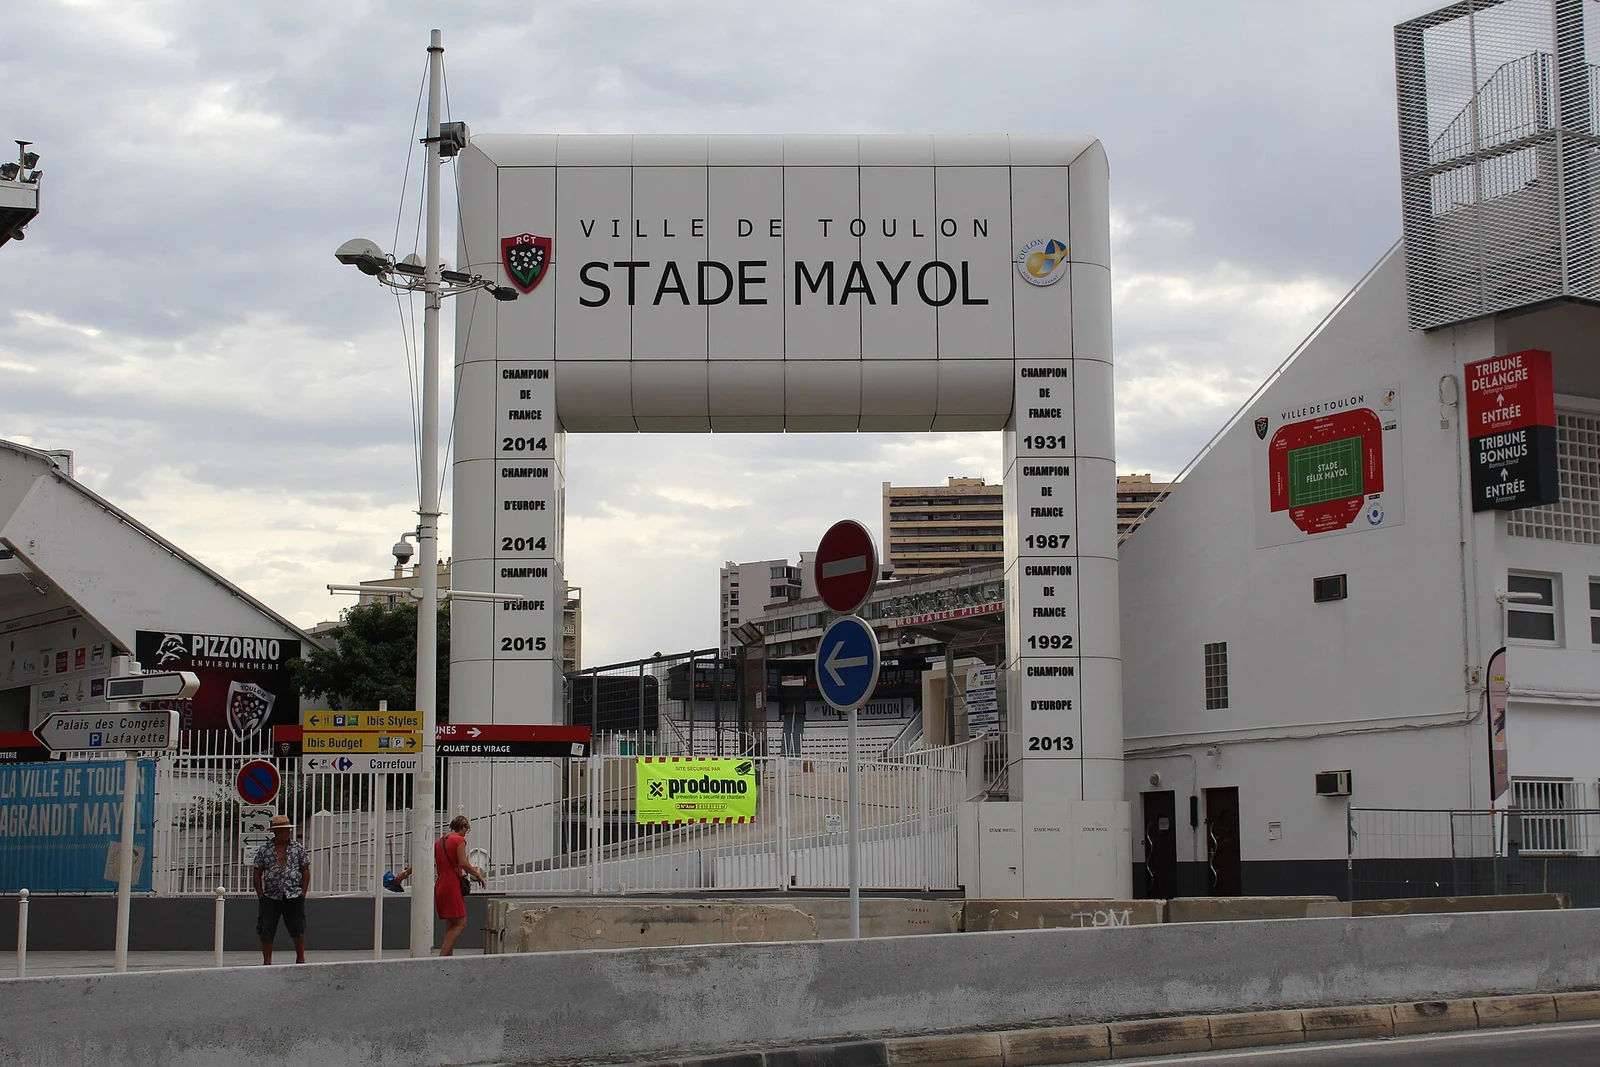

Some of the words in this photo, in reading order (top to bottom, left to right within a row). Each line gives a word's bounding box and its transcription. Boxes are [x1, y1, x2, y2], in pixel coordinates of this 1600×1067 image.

[580, 219, 704, 238] VILLE
[738, 219, 782, 238] DE
[818, 218, 989, 238] TOULON
[516, 234, 537, 245] RCT
[1018, 238, 1044, 266] TOULON
[579, 260, 768, 307] STADE
[794, 260, 989, 307] MAYOL
[1475, 355, 1523, 377] TRIBUNE
[502, 369, 549, 380] CHAMPION
[1020, 367, 1067, 379] CHAMPION
[1471, 367, 1529, 392] DELANGRE
[520, 389, 531, 400] DE
[1039, 388, 1050, 399] DE
[1482, 386, 1503, 396] Delangre
[1503, 383, 1518, 392] Stand
[1029, 408, 1062, 419] FRANCE
[1281, 408, 1307, 420] VILLE
[1309, 404, 1321, 414] DE
[1324, 395, 1365, 412] TOULON
[508, 410, 542, 420] FRANCE
[1481, 404, 1522, 425] ENTRÉE
[1491, 420, 1512, 429] Entrance
[502, 437, 547, 451] 2014
[1023, 435, 1067, 450] 1931
[1479, 430, 1527, 451] TRIBUNE
[1480, 444, 1528, 464] BONNUS
[1317, 461, 1338, 472] STADE
[1488, 460, 1505, 469] Bonnus
[1505, 457, 1519, 466] Stand
[501, 467, 549, 478] CHAMPION
[1022, 466, 1070, 477] CHAMPION
[1306, 472, 1323, 483] FÉLIX
[1324, 468, 1348, 480] MAYOL
[1041, 486, 1052, 497] DE
[1485, 478, 1526, 499] ENTRÉE
[504, 500, 546, 511] D'EUROPE
[1495, 495, 1516, 504] Entrance
[1030, 507, 1064, 518] FRANCE
[501, 537, 547, 551] 2014
[1025, 534, 1070, 549] 1987
[501, 567, 548, 578] CHAMPION
[1024, 565, 1072, 576] CHAMPION
[1043, 586, 1055, 597] DE
[897, 611, 956, 626] MONTANER
[1032, 607, 1066, 618] FRANCE
[191, 635, 280, 661] PIZZORNO
[501, 637, 547, 651] 2015
[1027, 635, 1073, 650] 1992
[191, 659, 280, 671] ENVIRONNEMENT
[1026, 666, 1074, 677] CHAMPION
[240, 685, 266, 698] TOULON
[865, 703, 900, 716] TOULON
[1030, 699, 1073, 711] D'EUROPE
[56, 719, 89, 730] Palais
[95, 718, 114, 730] des
[120, 717, 166, 731] Congrès
[367, 715, 384, 726] Ibis
[388, 715, 418, 728] Styles
[106, 732, 165, 745] Lafayette
[307, 738, 325, 748] Ibis
[329, 737, 363, 750] Budget
[1028, 736, 1074, 751] 2013
[442, 745, 470, 753] QUART
[472, 745, 482, 753] DE
[483, 745, 511, 753] VIRAGE
[369, 758, 416, 769] Carrefour
[1, 770, 16, 798] LA
[21, 769, 60, 798] VILLE
[64, 768, 81, 797] DE
[86, 767, 145, 796] TOULN
[668, 774, 747, 800] prodomo
[0, 803, 78, 837] AGRANDIT
[83, 802, 146, 836] MAYL
